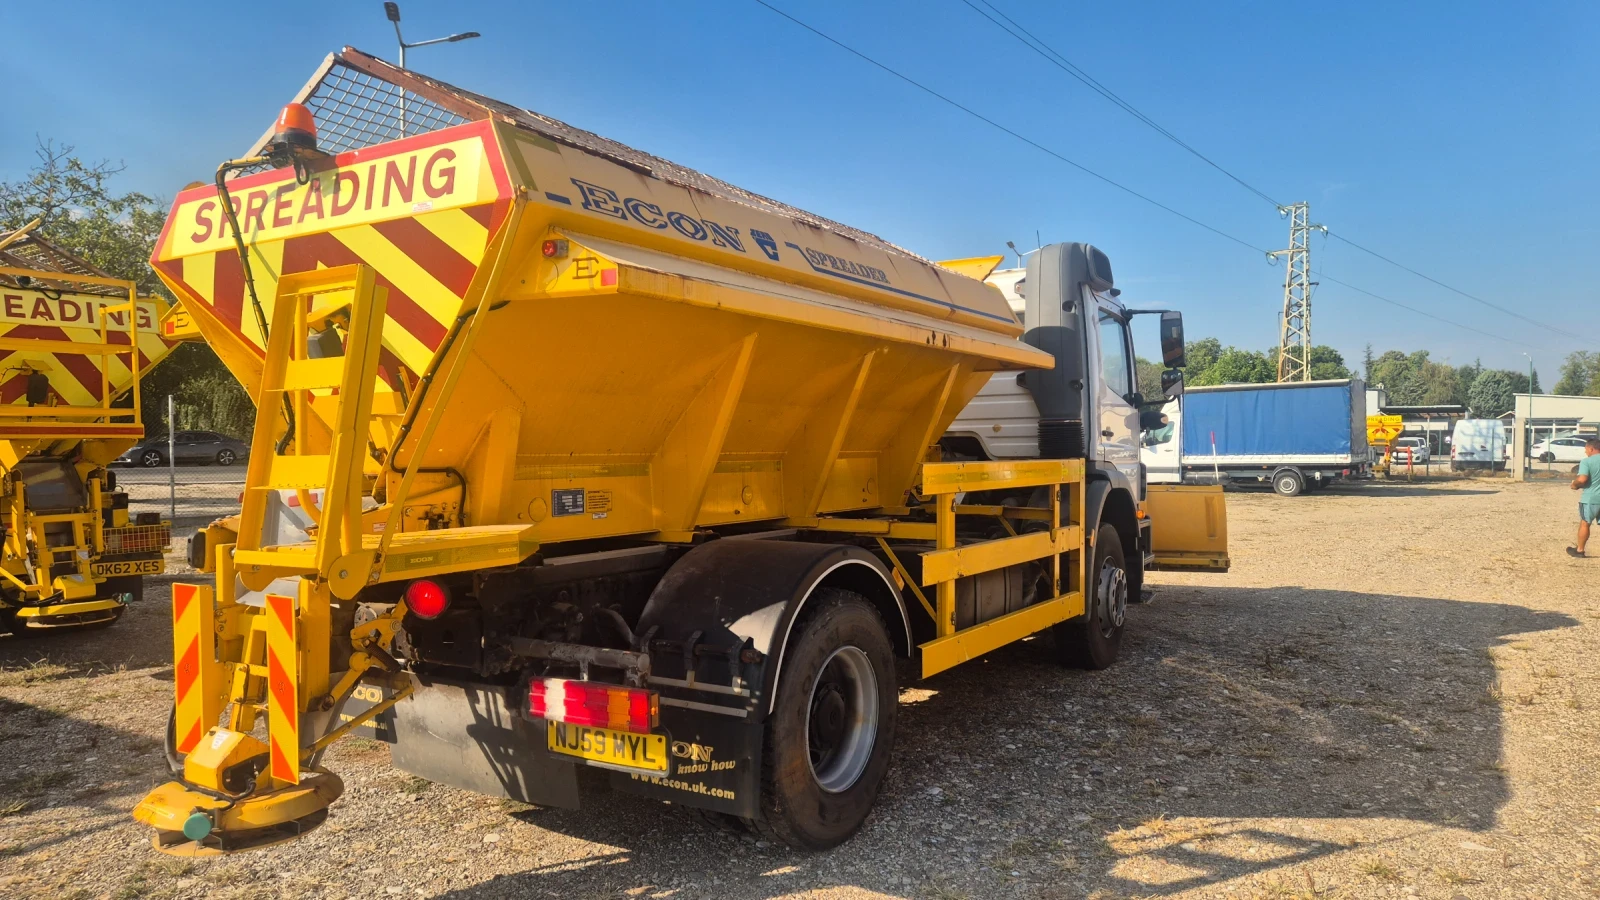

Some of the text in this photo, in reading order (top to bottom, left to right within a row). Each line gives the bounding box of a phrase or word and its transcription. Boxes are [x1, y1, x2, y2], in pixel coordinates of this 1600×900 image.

[190, 148, 457, 243] SPREADING
[570, 177, 746, 252] ECON
[572, 256, 599, 279] E
[805, 247, 890, 284] SPREADER
[97, 561, 159, 575] DK62 XES
[351, 685, 383, 703] CO
[555, 723, 656, 763] NJ59 MYL
[677, 760, 736, 774] know how
[630, 773, 735, 799] www.econ.uk.com
